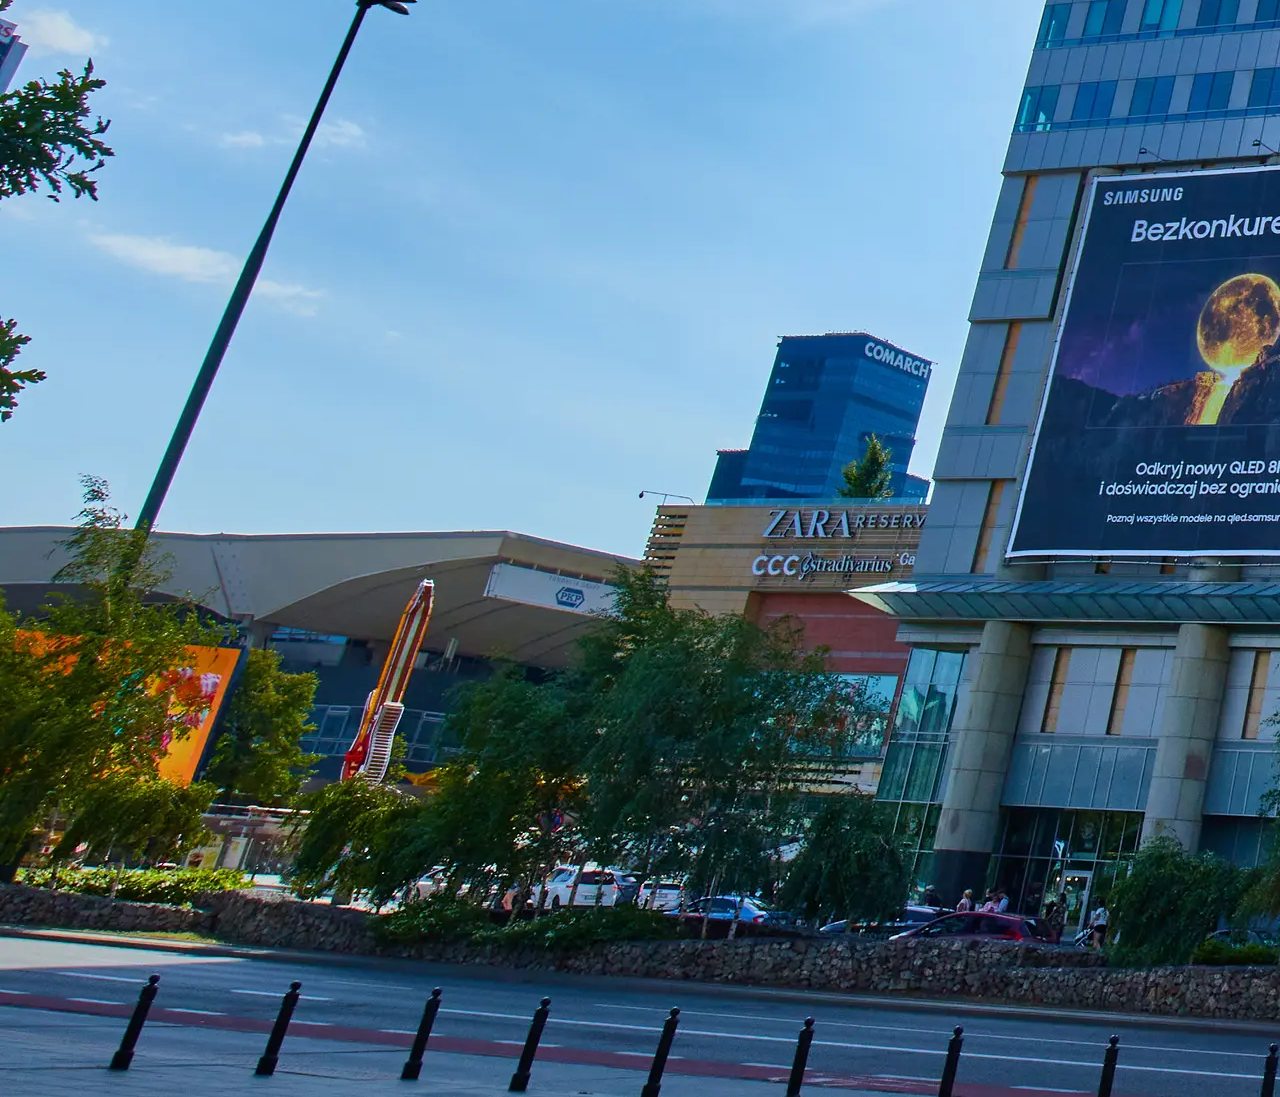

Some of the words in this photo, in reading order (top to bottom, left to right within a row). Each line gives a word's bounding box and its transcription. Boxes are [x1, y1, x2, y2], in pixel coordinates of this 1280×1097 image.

[1104, 187, 1184, 206] SAMSUNG
[864, 341, 930, 379] COMARCH
[1136, 461, 1184, 479] Odkryj
[1185, 463, 1227, 478] nowy
[1229, 460, 1266, 474] QLED
[1099, 481, 1105, 496] i
[1106, 480, 1198, 499] doświadczaj
[1199, 480, 1228, 495] bez
[762, 509, 852, 538] ZARA
[855, 514, 927, 528] RESERV
[1106, 514, 1135, 524] Poznaj
[1136, 514, 1178, 524] wszystkie
[1179, 514, 1212, 523] modele
[752, 555, 799, 576] CCC
[560, 592, 582, 602] PKP
